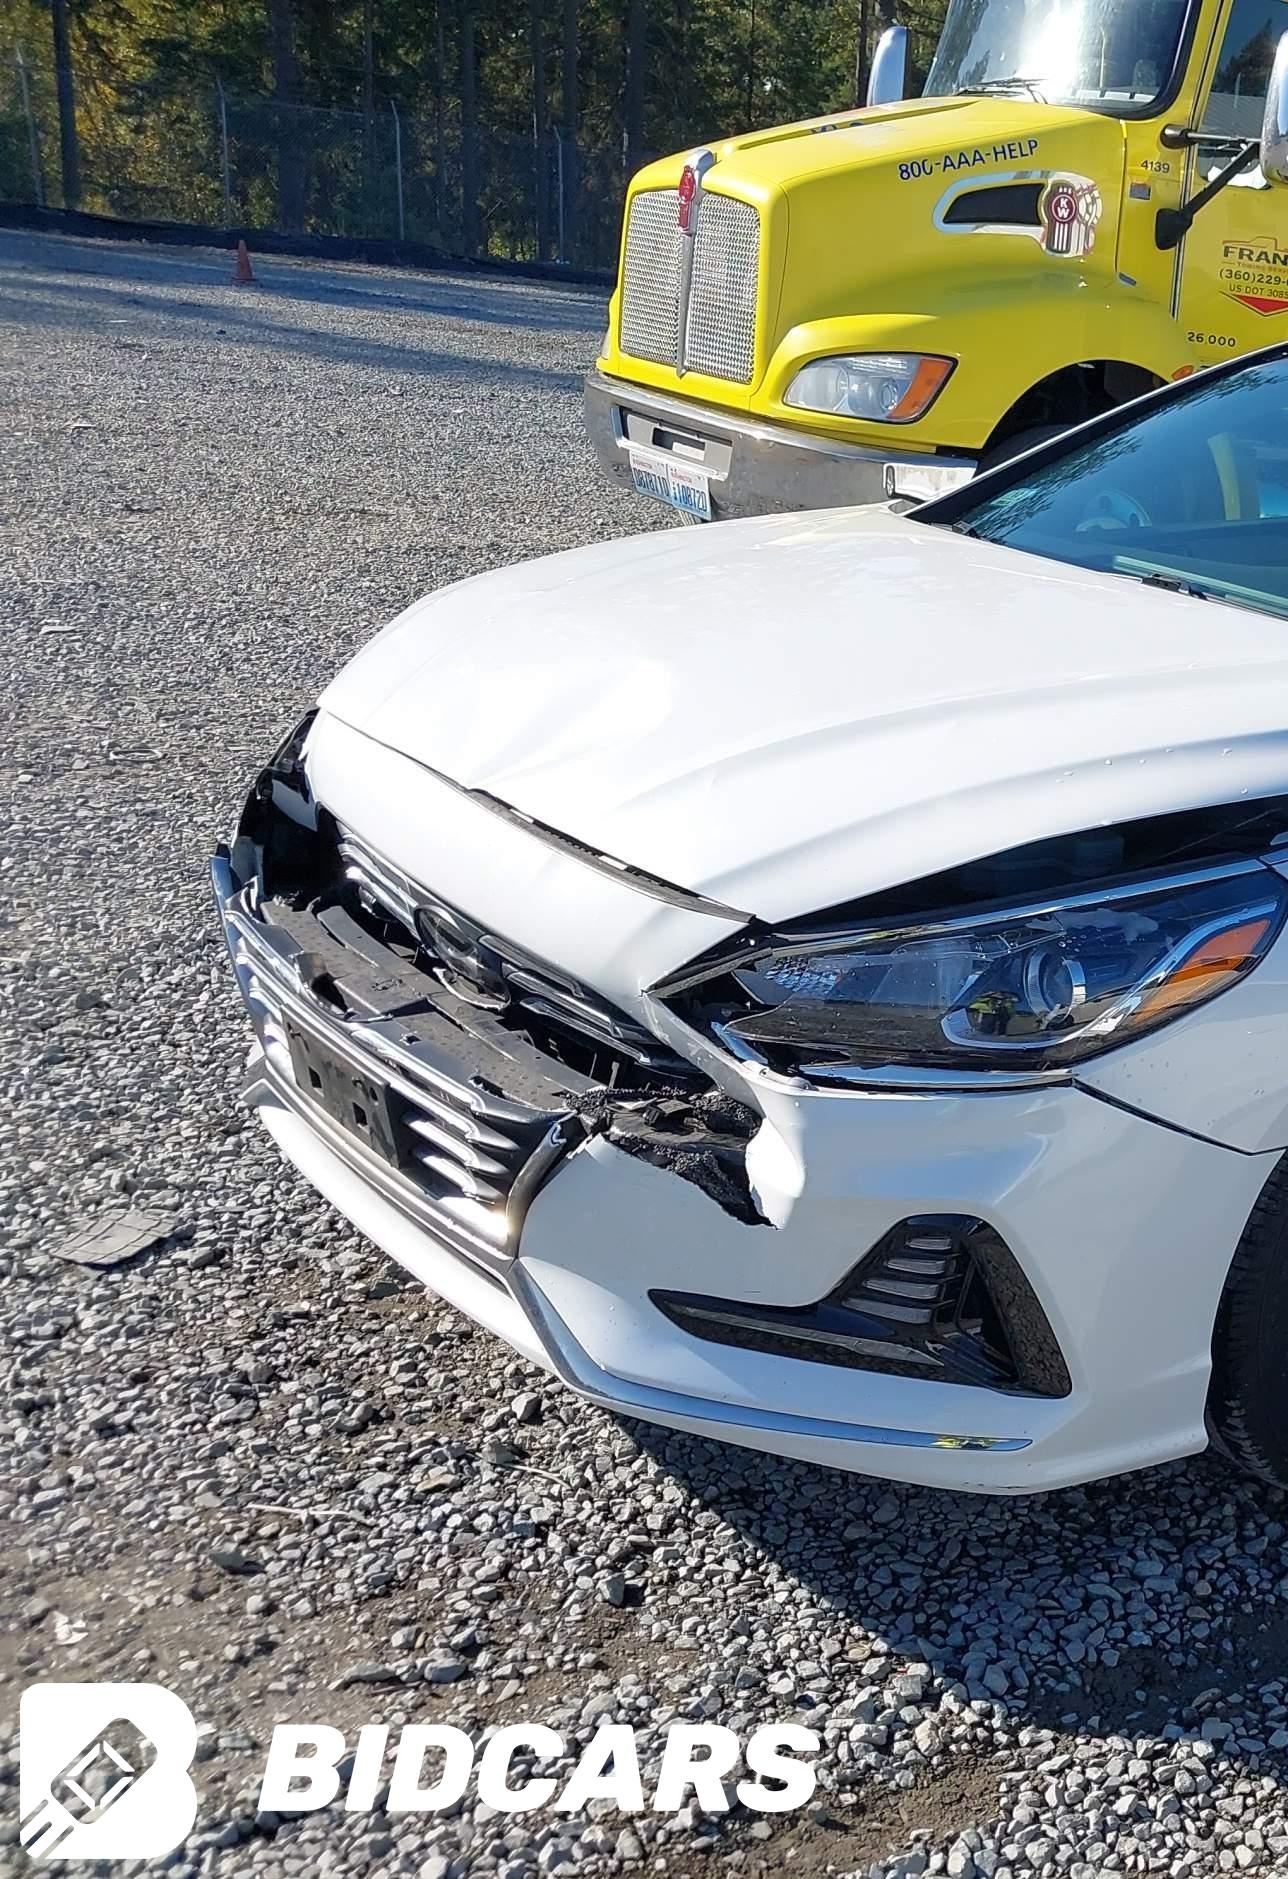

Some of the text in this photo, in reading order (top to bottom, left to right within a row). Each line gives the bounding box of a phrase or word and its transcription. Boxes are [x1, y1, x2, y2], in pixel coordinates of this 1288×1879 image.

[1140, 160, 1170, 173] 4139
[1229, 283, 1242, 293] US
[1245, 286, 1264, 296] DOT
[1187, 331, 1236, 347] 26 000
